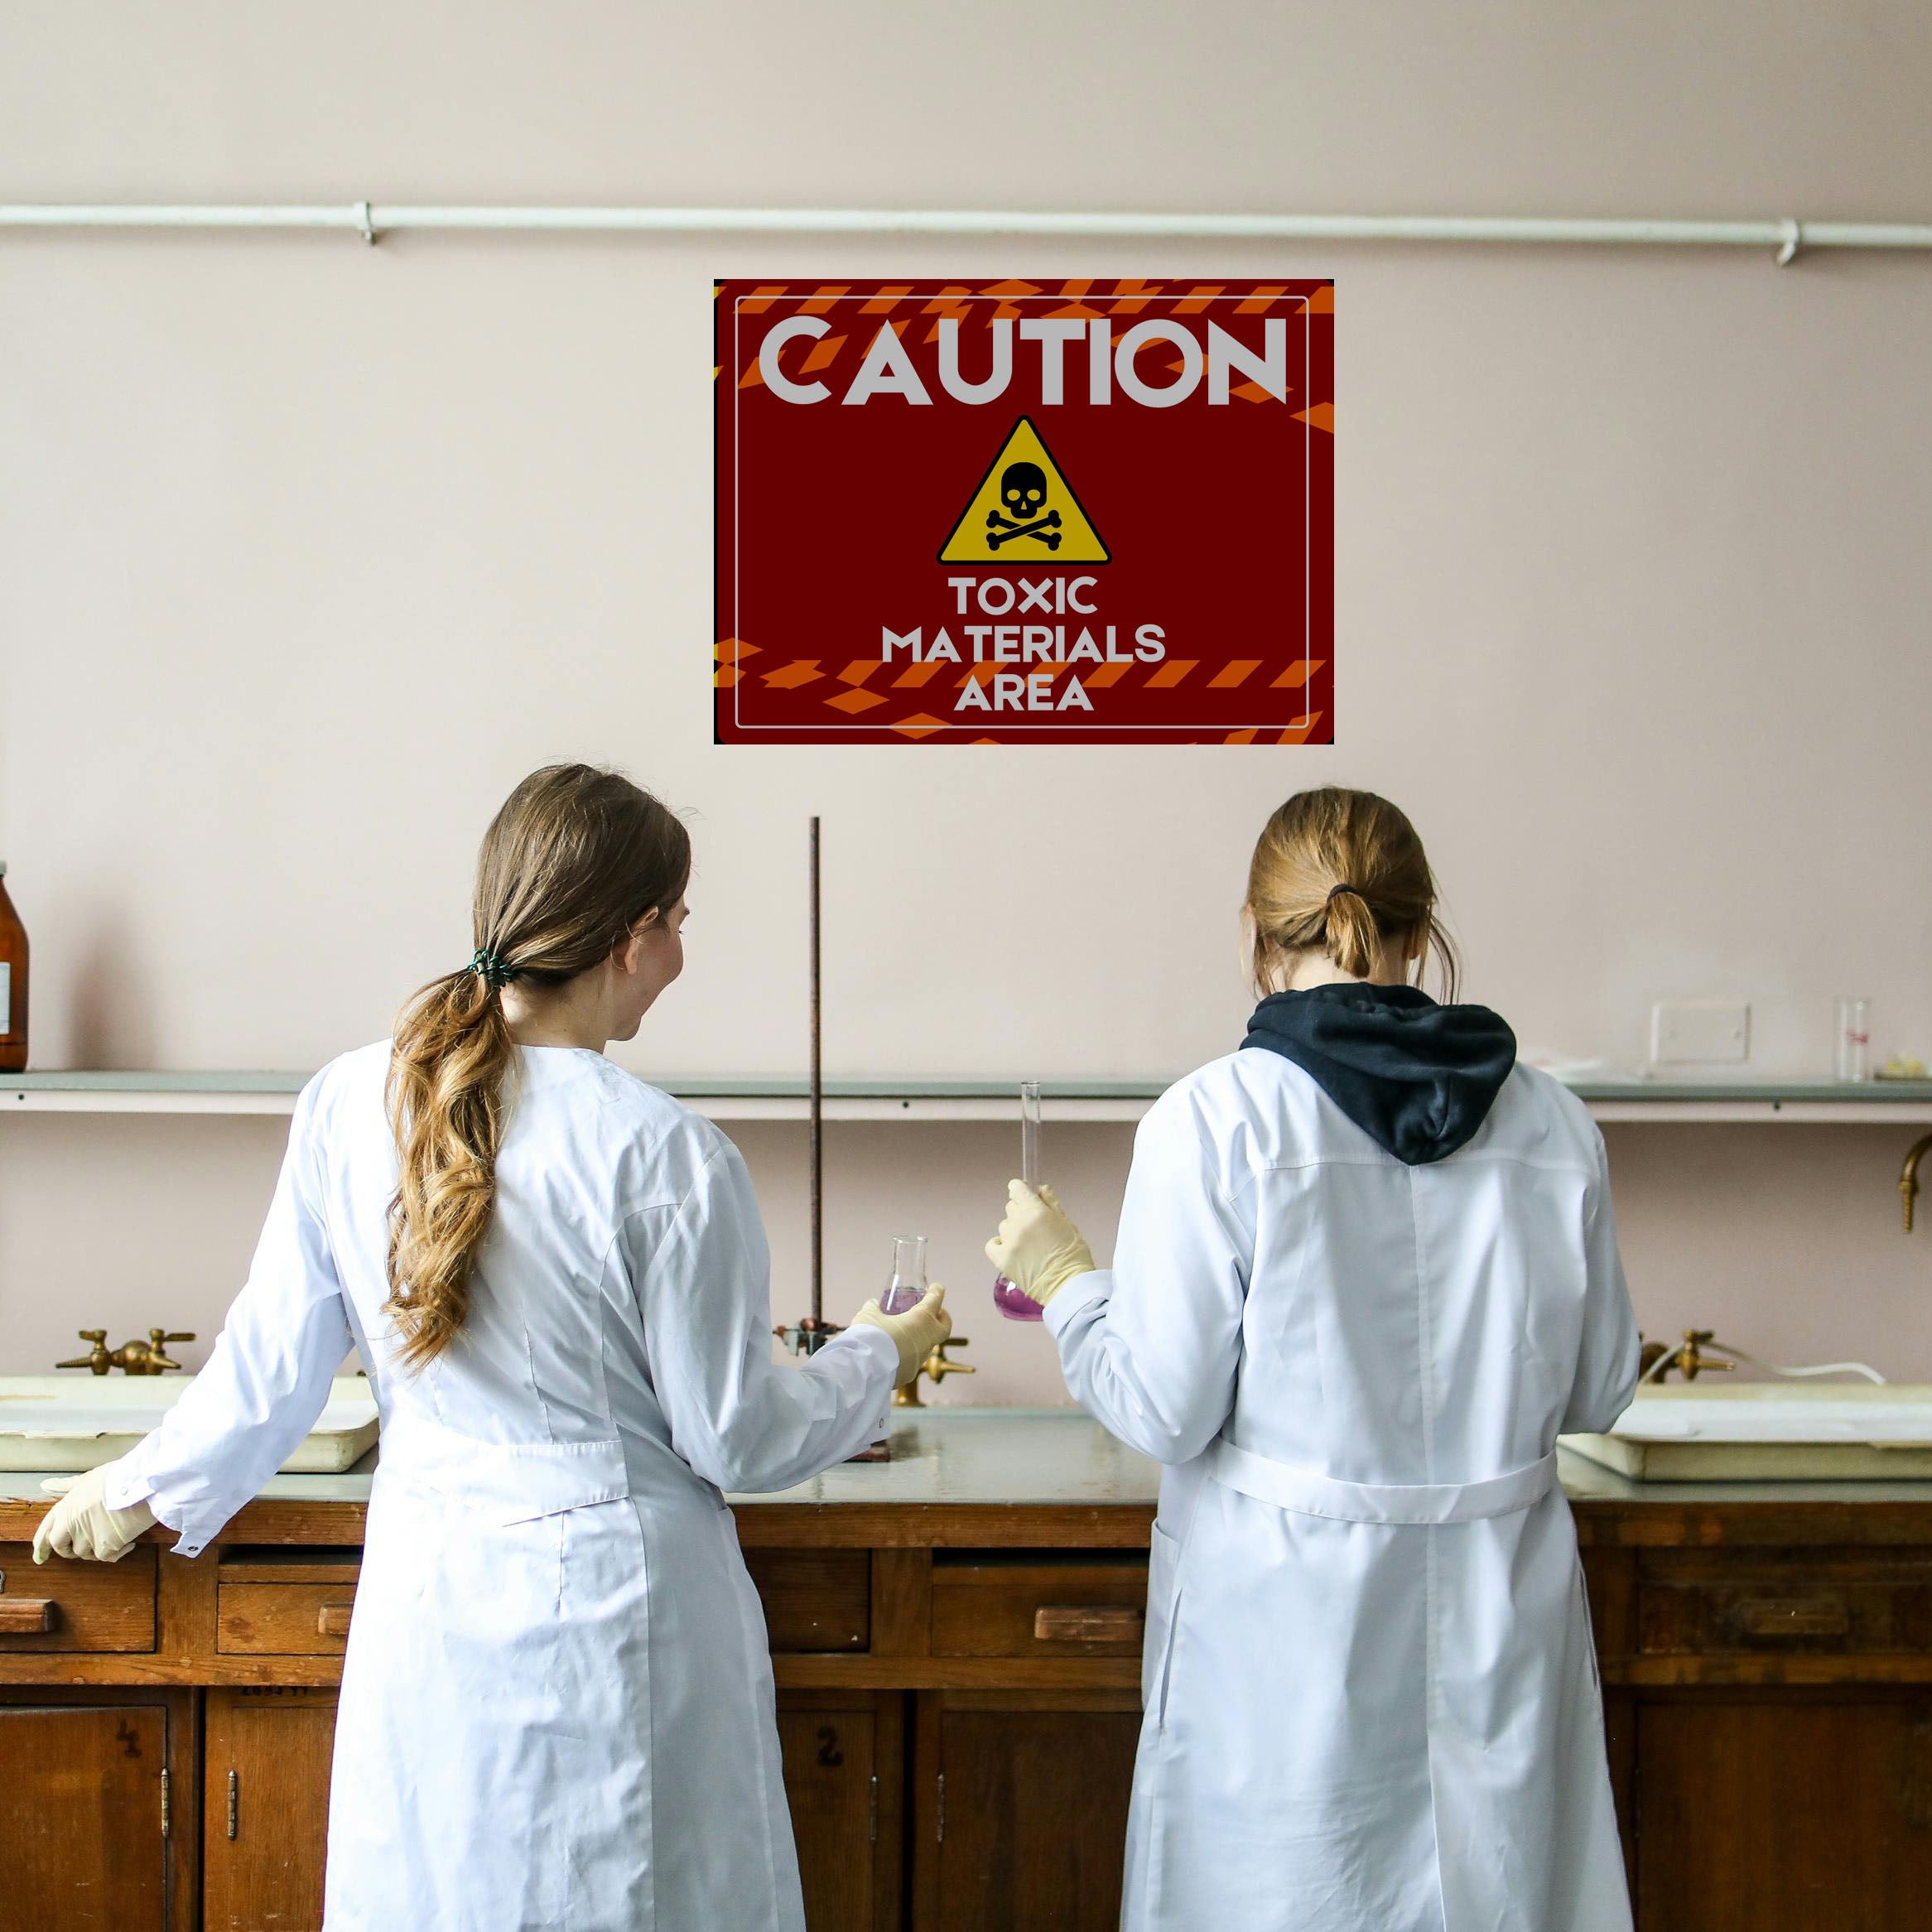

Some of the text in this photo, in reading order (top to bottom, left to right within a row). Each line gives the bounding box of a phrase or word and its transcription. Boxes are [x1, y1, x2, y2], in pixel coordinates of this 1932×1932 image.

[759, 316, 1287, 408] CAUTION
[947, 576, 1098, 616] TOXIC
[882, 624, 1166, 662] MATERIALS
[953, 673, 1095, 711] AREA
[817, 1725, 844, 1767] 2
